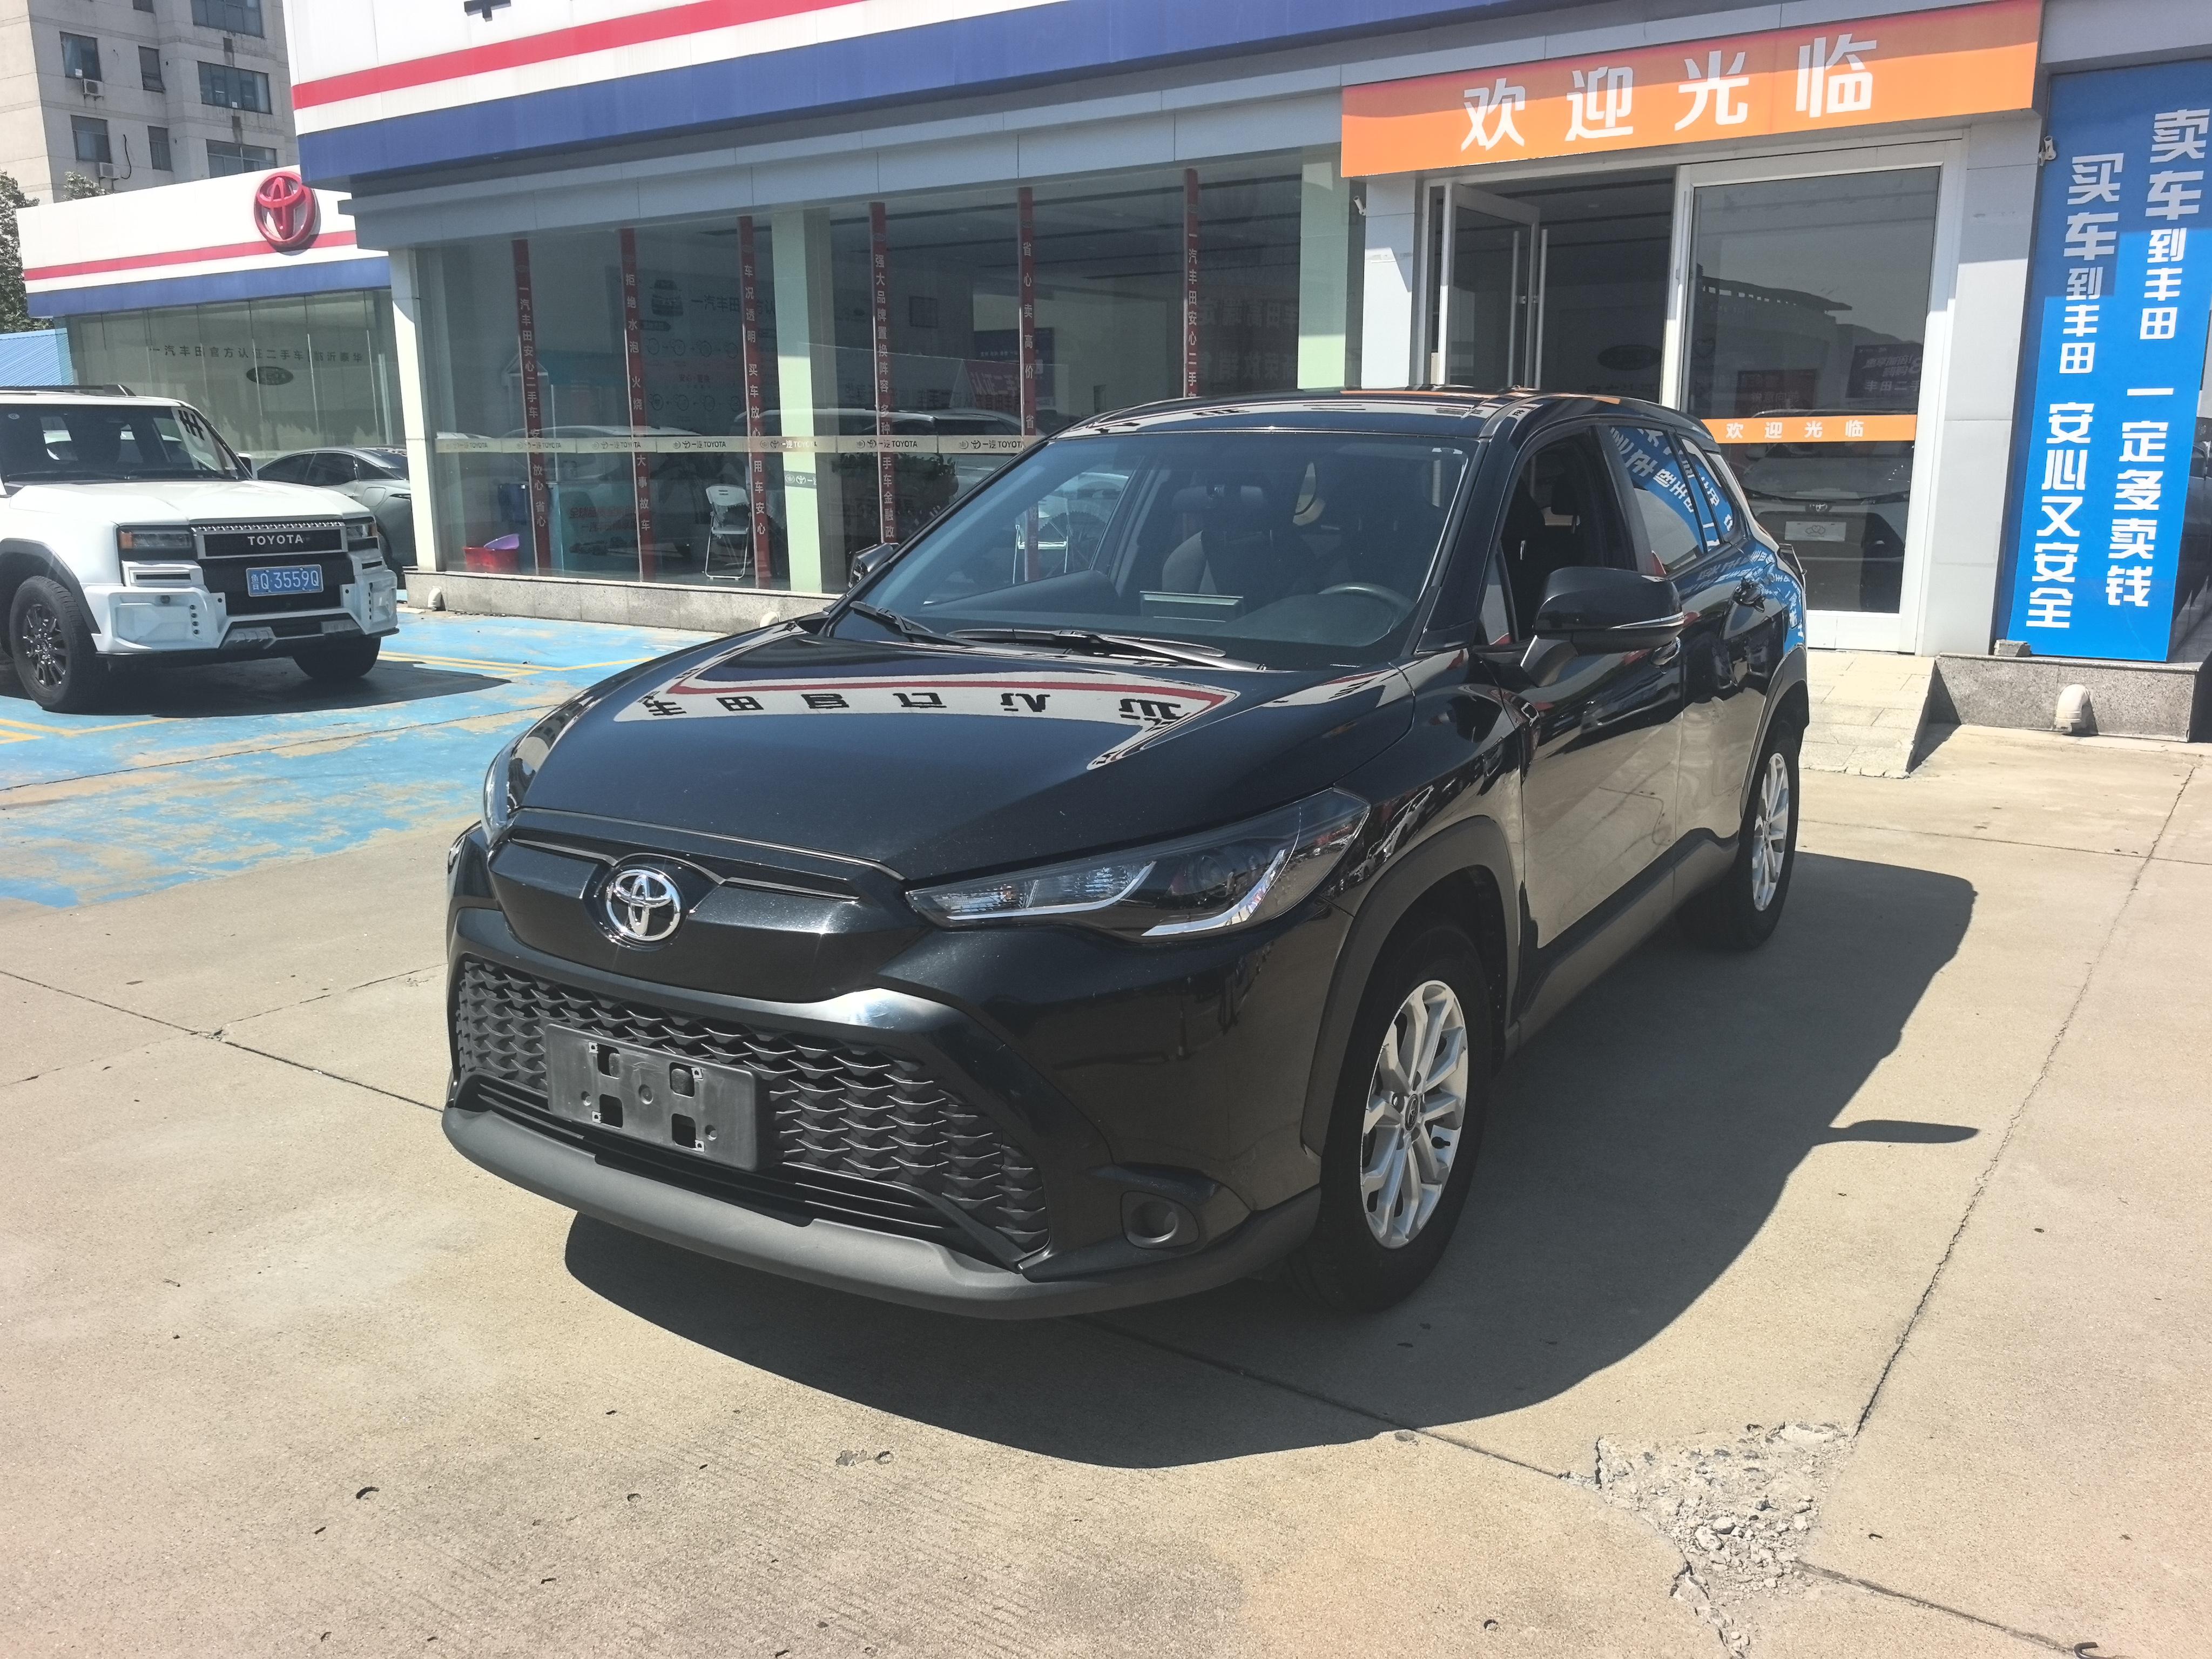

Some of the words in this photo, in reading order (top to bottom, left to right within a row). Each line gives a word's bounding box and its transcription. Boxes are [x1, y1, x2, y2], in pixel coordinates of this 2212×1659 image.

[1461, 33, 1877, 151] 欢迎光临
[2059, 153, 2124, 374] 买车到丰田
[2140, 109, 2210, 340] 卖车到丰田
[519, 287, 538, 418] 一汽丰田安心二手车
[625, 273, 639, 353] 拒绝水泡
[875, 254, 889, 393] 强大品牌置换阵容
[744, 265, 756, 343] 车况透明
[754, 460, 766, 535] 用车安心
[1725, 420, 1864, 439] 欢迎光临
[881, 404, 895, 538] 多种手车金融政
[2026, 402, 2094, 629] 安心又安全
[2106, 388, 2174, 607] 一定多卖钱
[247, 534, 304, 545] TOYOTA
